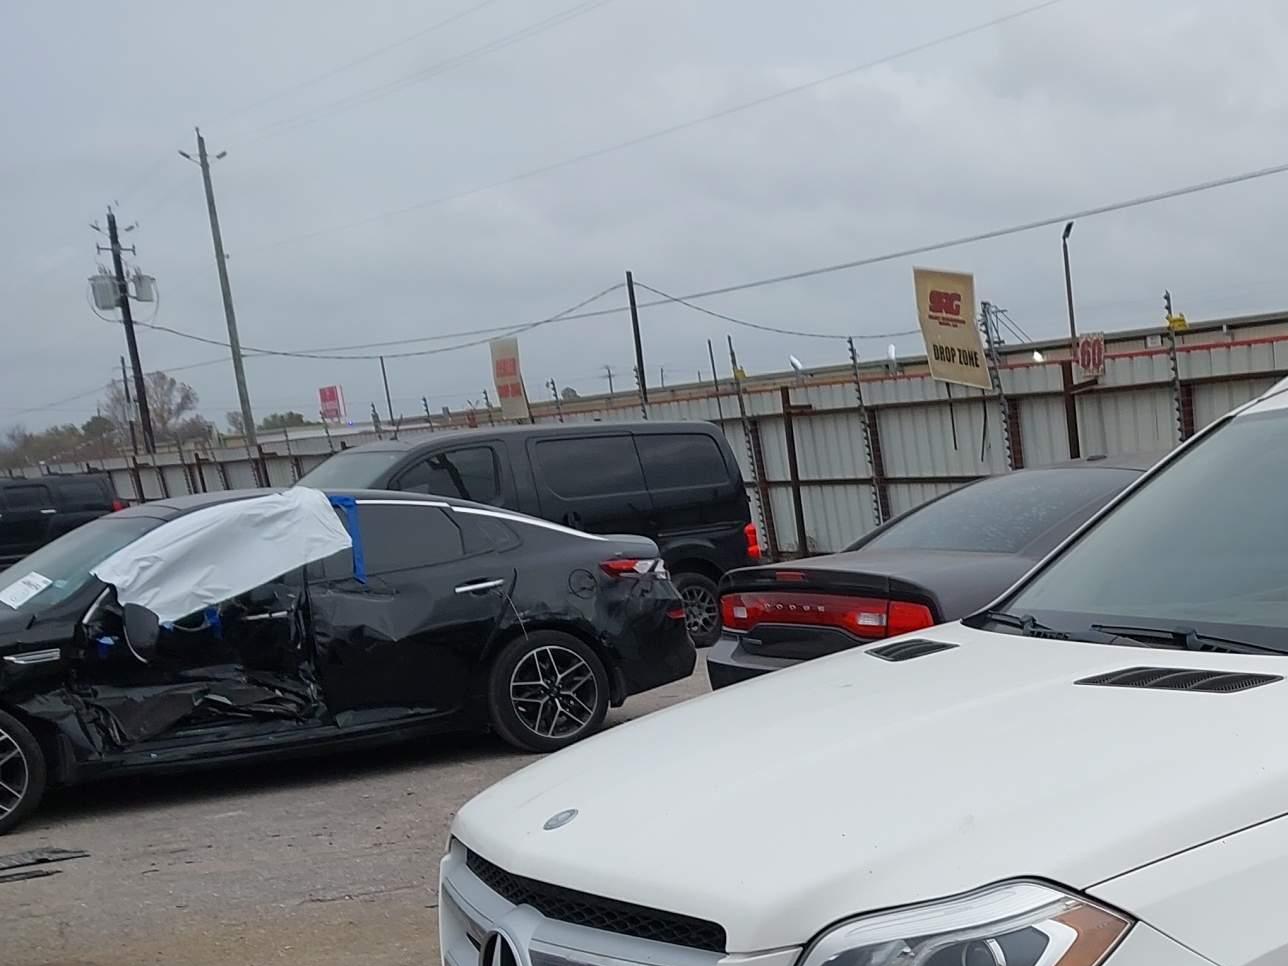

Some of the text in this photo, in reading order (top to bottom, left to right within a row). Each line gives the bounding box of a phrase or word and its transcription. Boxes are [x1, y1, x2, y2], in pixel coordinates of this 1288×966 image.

[933, 344, 980, 368] DROP ZONE
[1078, 338, 1104, 370] 60
